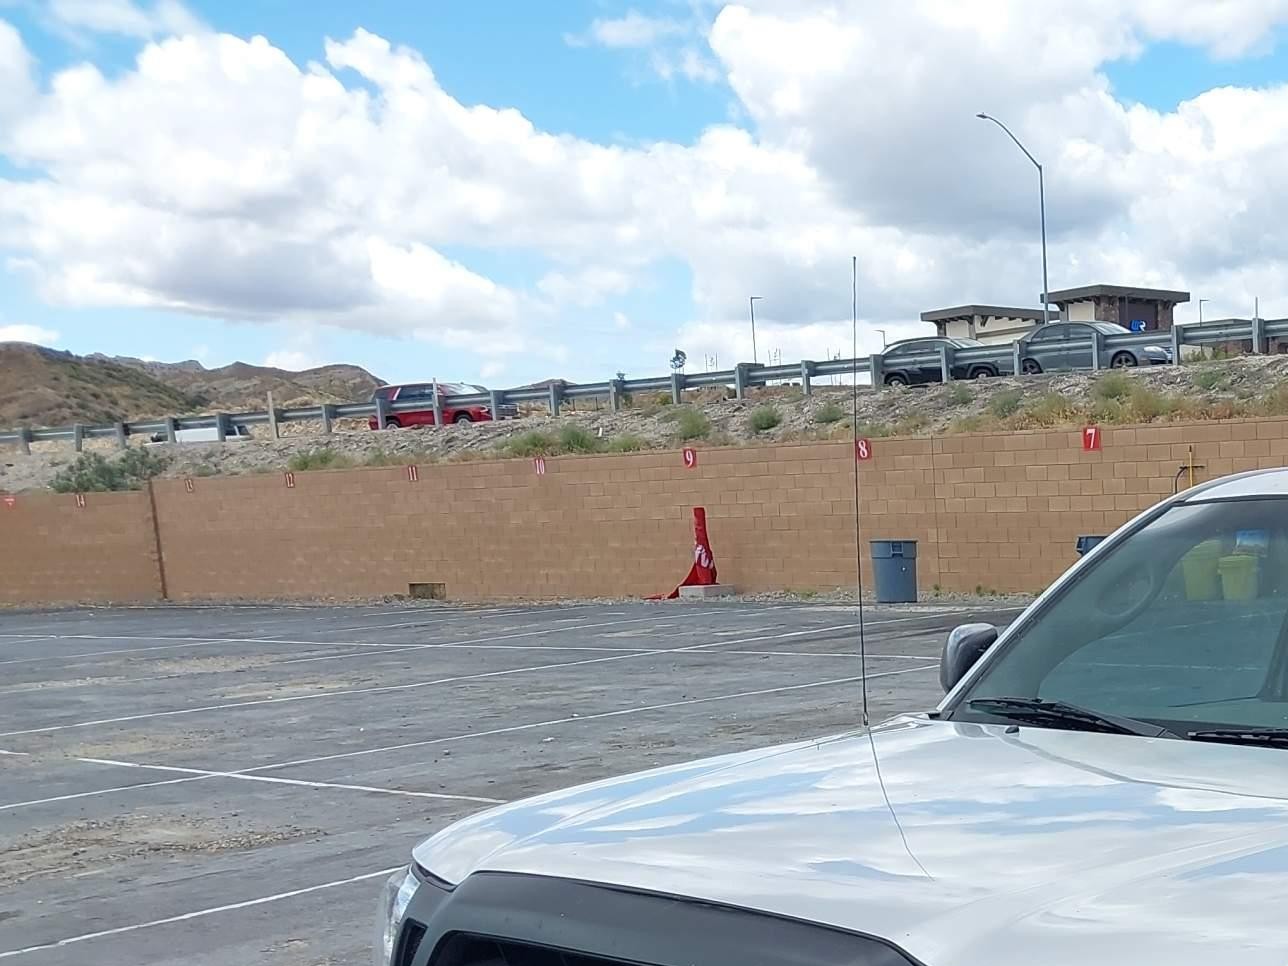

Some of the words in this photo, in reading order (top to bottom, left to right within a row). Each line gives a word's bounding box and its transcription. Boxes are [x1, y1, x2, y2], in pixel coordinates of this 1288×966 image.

[1086, 428, 1096, 449] 7
[858, 440, 869, 458] 8
[535, 459, 546, 475] 10
[685, 450, 694, 467] 9
[408, 466, 418, 481] 11
